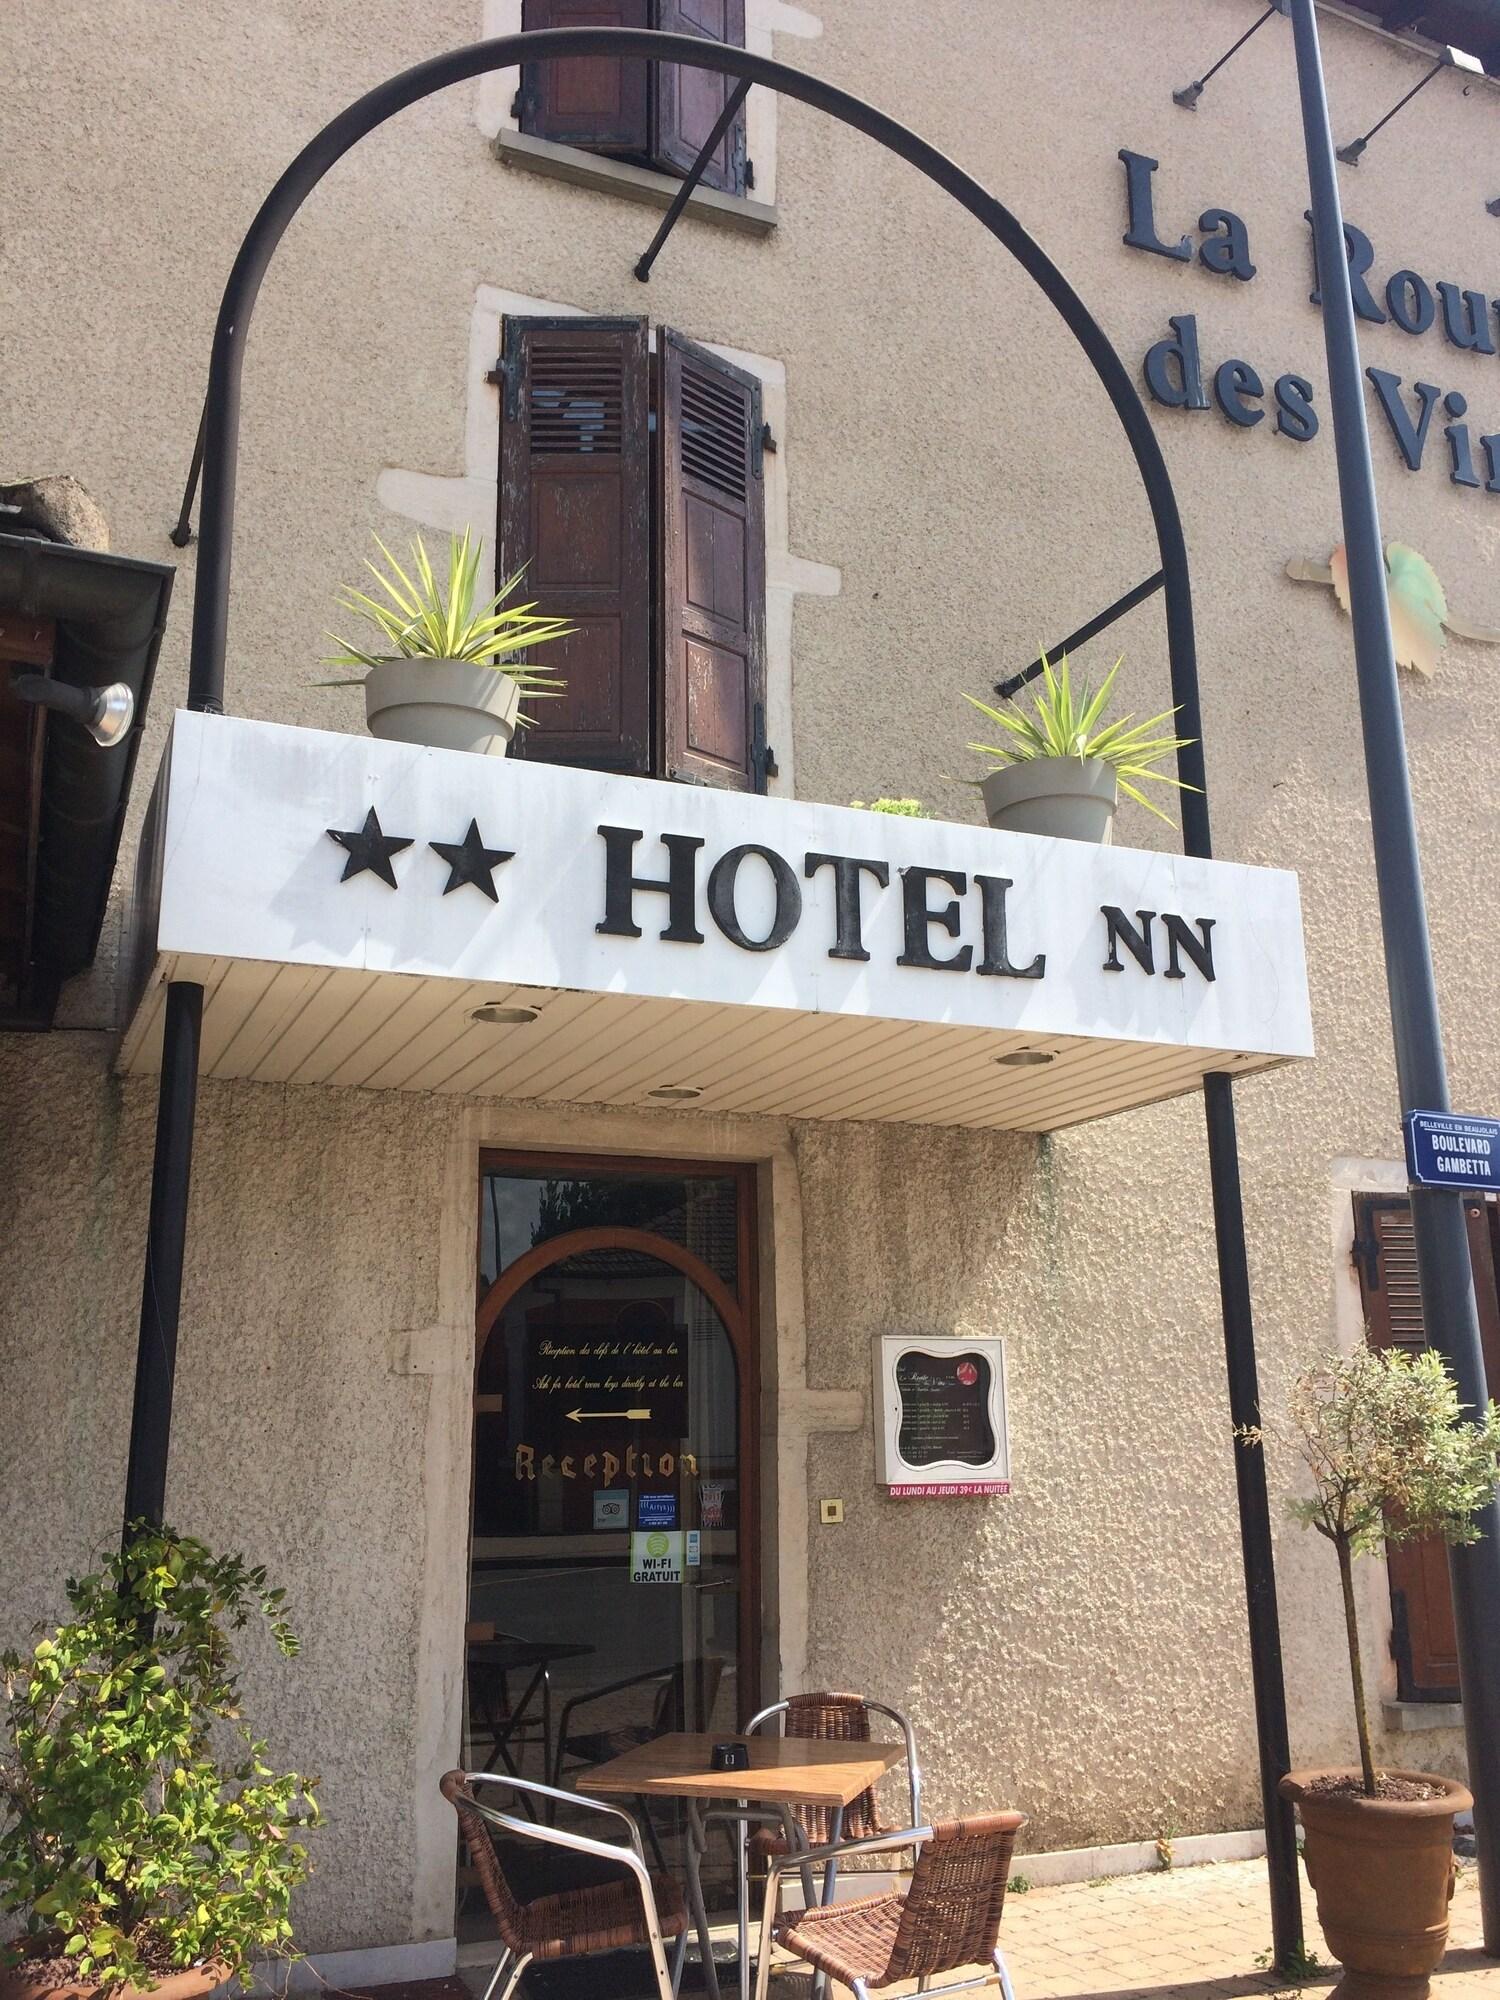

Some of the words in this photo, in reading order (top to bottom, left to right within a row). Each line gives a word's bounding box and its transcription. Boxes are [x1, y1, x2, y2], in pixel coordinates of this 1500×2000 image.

[1118, 149, 1256, 281] La
[1304, 209, 1500, 356] Rou
[1143, 314, 1319, 442] des
[595, 824, 1045, 980] HOTEL
[1100, 904, 1216, 981] NN
[1420, 1120, 1453, 1130] BELLEVILLE
[1454, 1123, 1463, 1131] EN
[1464, 1125, 1498, 1135] BEAUJOLAIS
[1431, 1134, 1491, 1155] BOULEVARD
[1436, 1156, 1492, 1176] GAMBETTA
[666, 1342, 679, 1355] bar
[532, 1374, 553, 1389] Ask
[549, 1376, 561, 1394] for
[603, 1376, 619, 1392] keys
[621, 1376, 646, 1392] directly
[648, 1378, 657, 1388] at
[659, 1375, 670, 1388] the
[673, 1374, 684, 1388] bar
[515, 1443, 699, 1487] Reception
[890, 1486, 901, 1496] DU
[902, 1486, 925, 1495] LUNDI
[926, 1486, 937, 1495] AU
[938, 1485, 958, 1495] JEUDI
[973, 1485, 982, 1494] LA
[642, 1558, 672, 1569] WI-FI
[633, 1571, 681, 1582] GRATUIT
